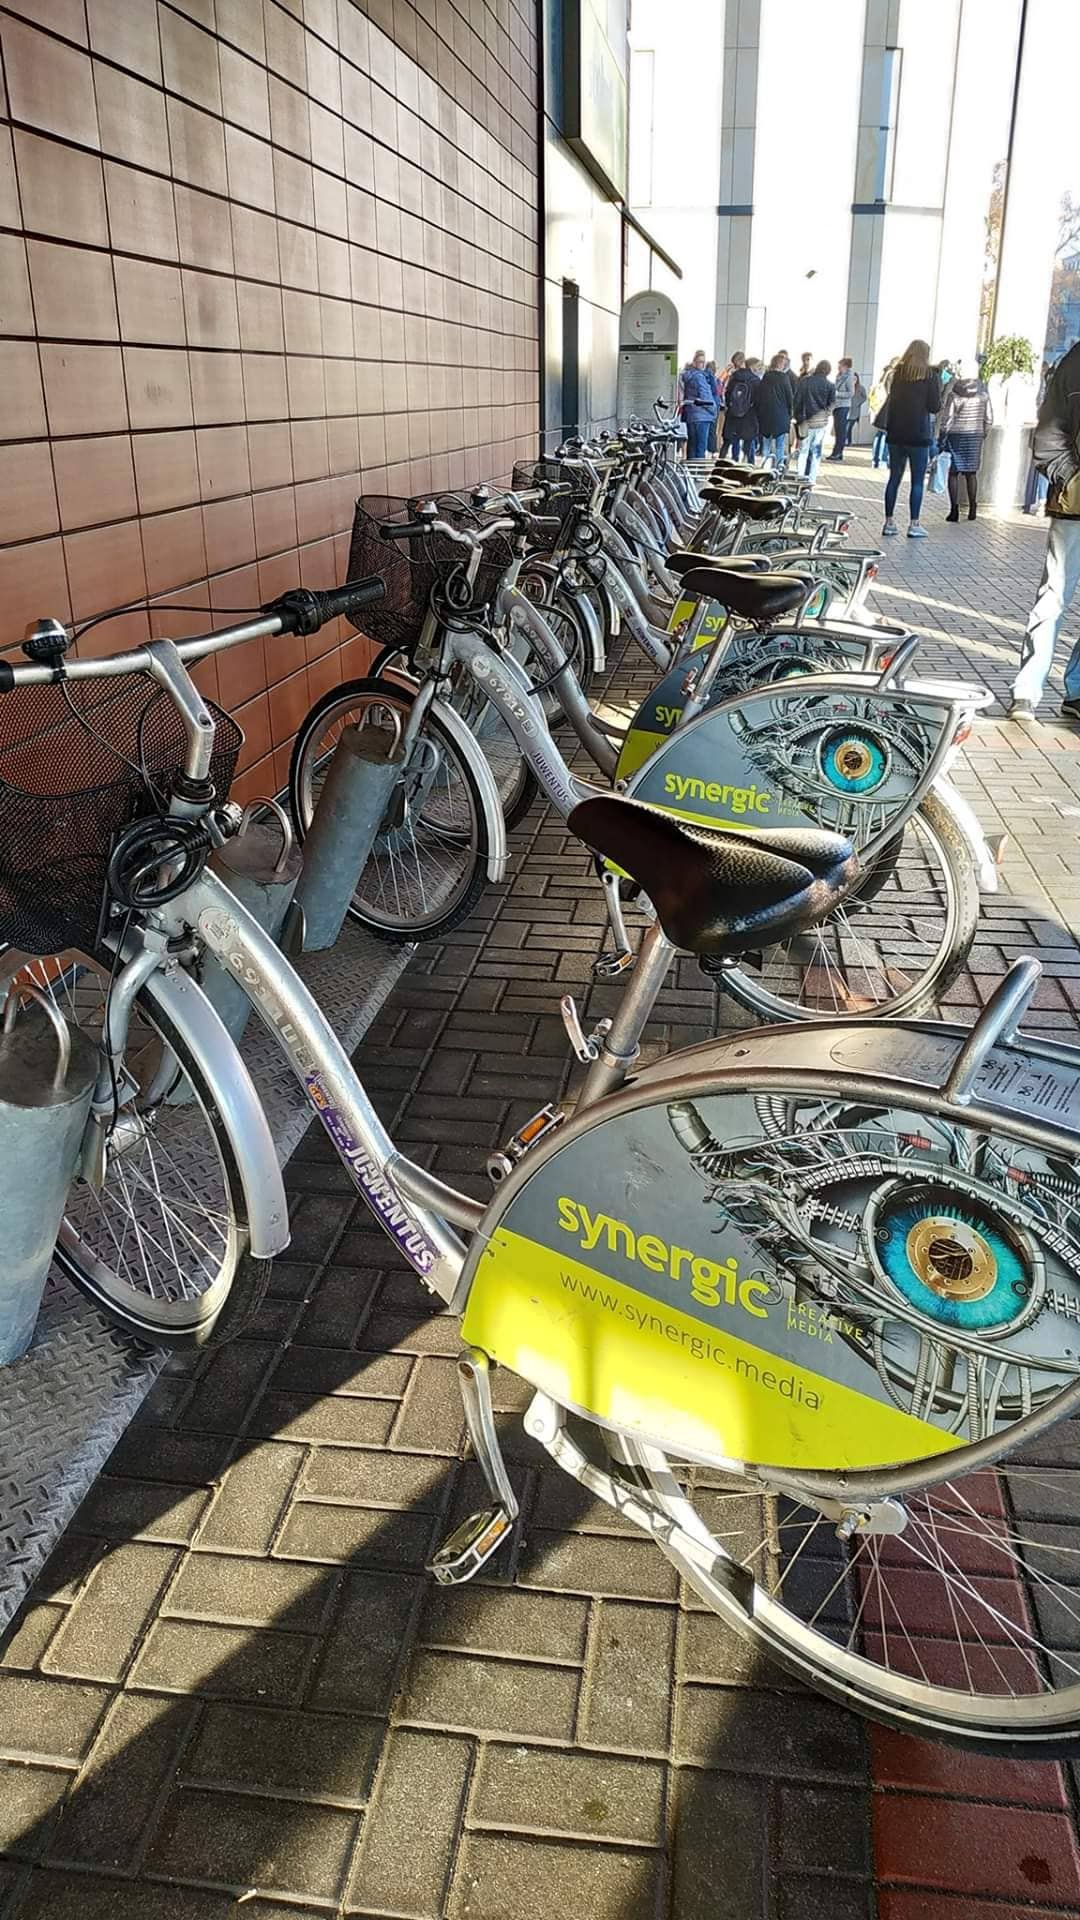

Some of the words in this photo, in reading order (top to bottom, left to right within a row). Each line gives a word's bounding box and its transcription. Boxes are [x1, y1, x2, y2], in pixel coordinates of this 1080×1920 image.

[489, 678, 525, 720] 67912
[533, 752, 570, 802] JUWENTUS
[664, 772, 771, 814] synergic
[557, 1196, 770, 1319] synergic
[560, 1271, 821, 1411] www.synergic.media
[787, 1317, 834, 1345] MEDIA
